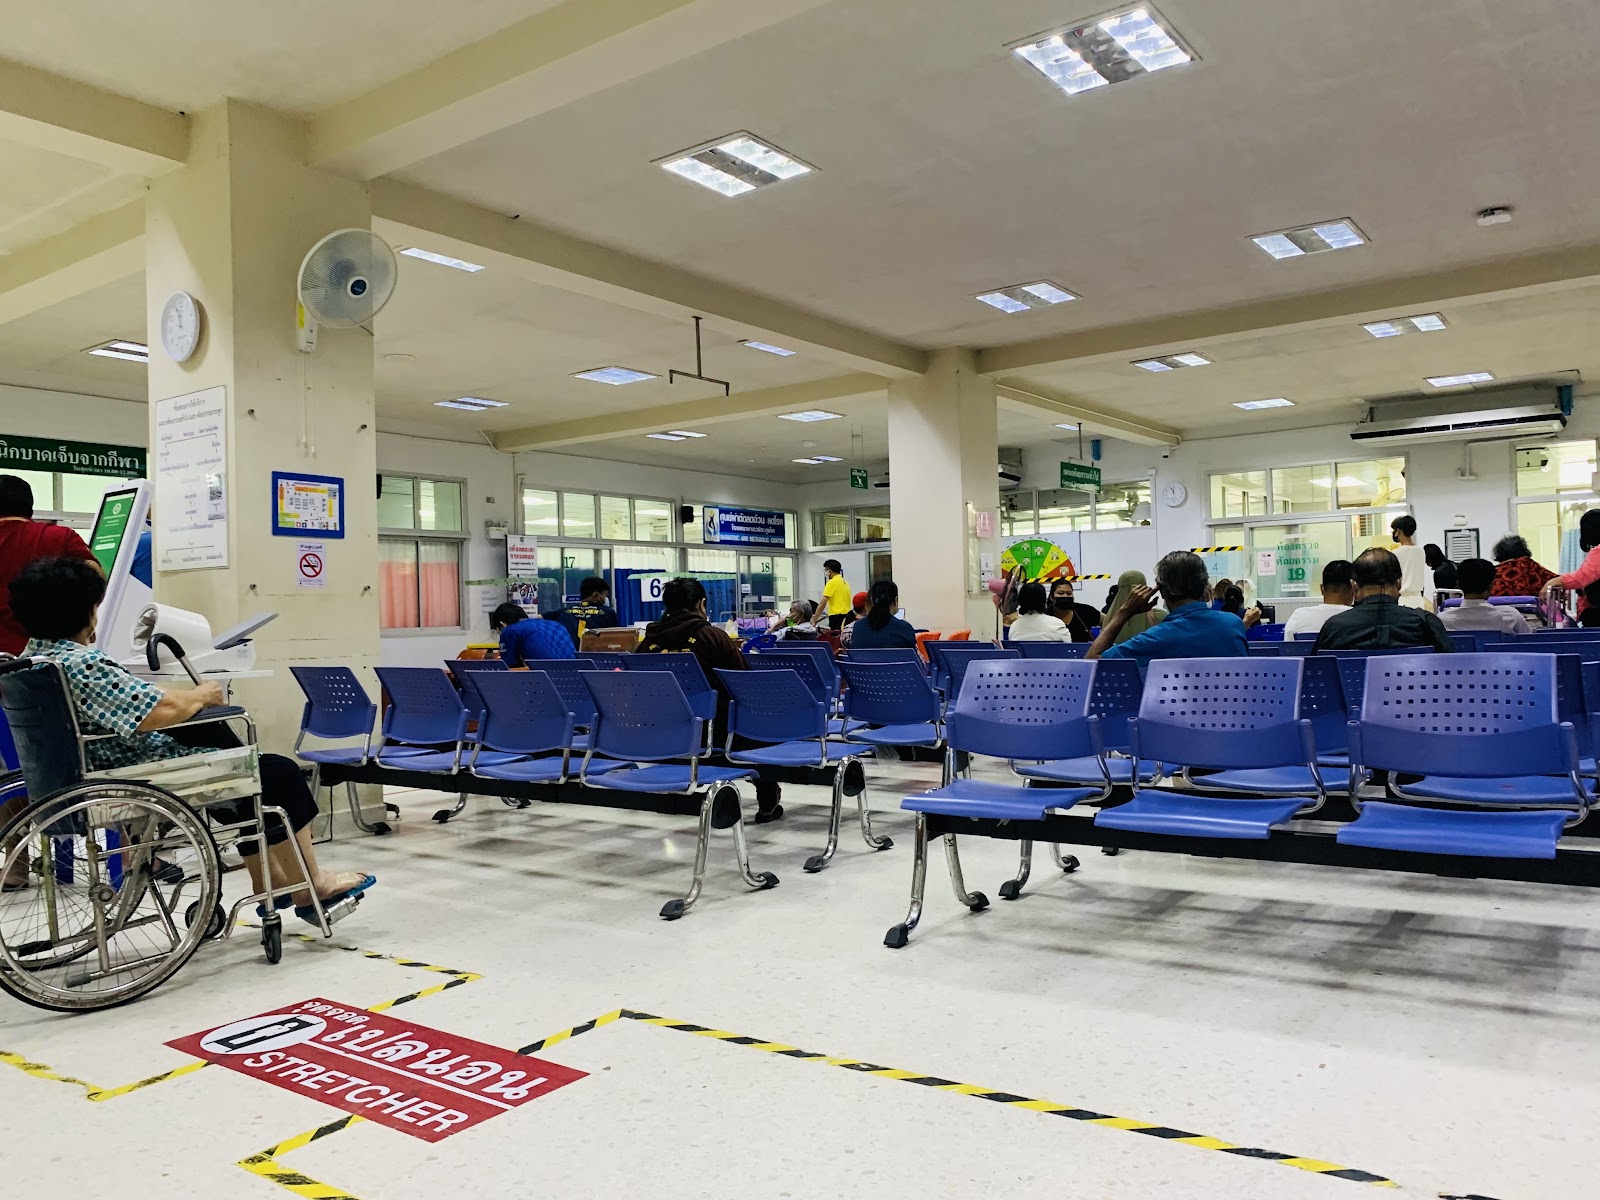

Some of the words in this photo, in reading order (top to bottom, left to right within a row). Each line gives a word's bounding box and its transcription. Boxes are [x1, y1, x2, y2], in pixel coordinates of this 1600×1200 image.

[1277, 542, 1319, 551] ห้องตรวจ
[563, 556, 575, 568] 17
[761, 562, 770, 573] 18
[1212, 562, 1218, 571] 4
[1287, 567, 1306, 581] 19
[650, 578, 661, 598] 6
[292, 1001, 371, 1025] จุดจอด
[321, 1024, 548, 1100] เปลนอน
[243, 1051, 469, 1133] STRETCHER
